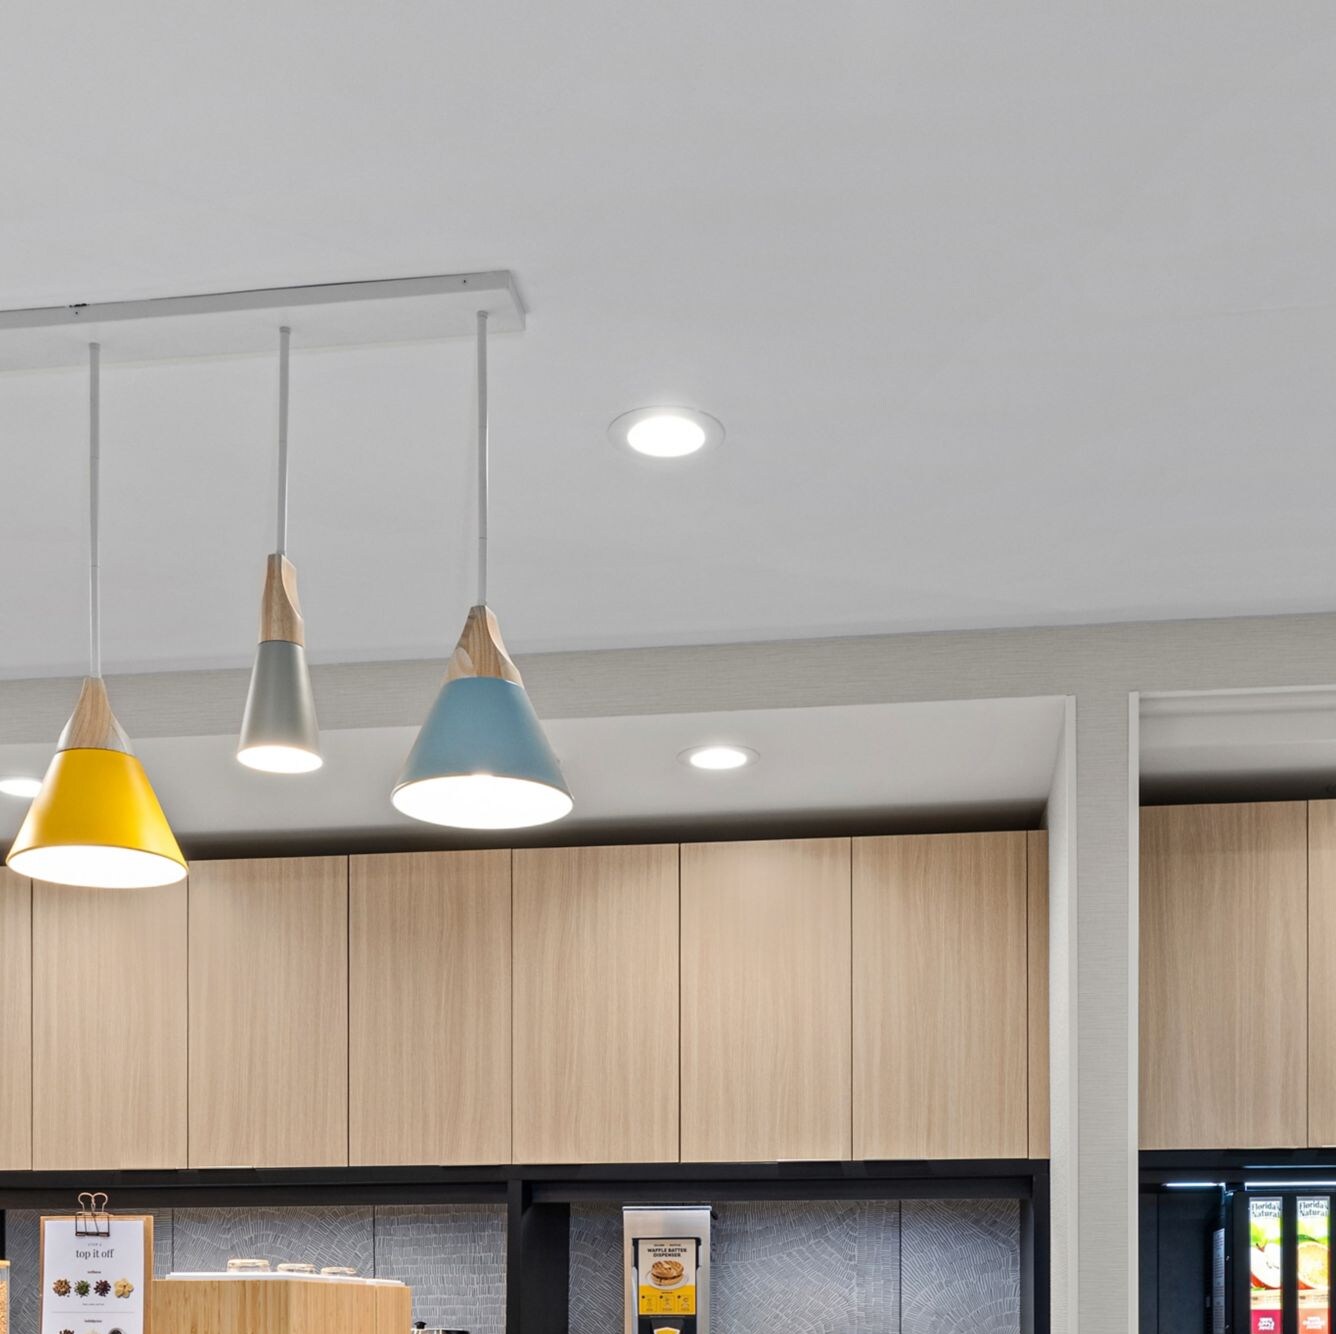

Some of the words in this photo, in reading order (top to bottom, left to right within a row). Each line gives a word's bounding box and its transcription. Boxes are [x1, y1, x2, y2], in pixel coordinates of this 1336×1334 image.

[76, 1249, 91, 1260] top
[93, 1249, 99, 1258] it
[101, 1248, 114, 1258] off
